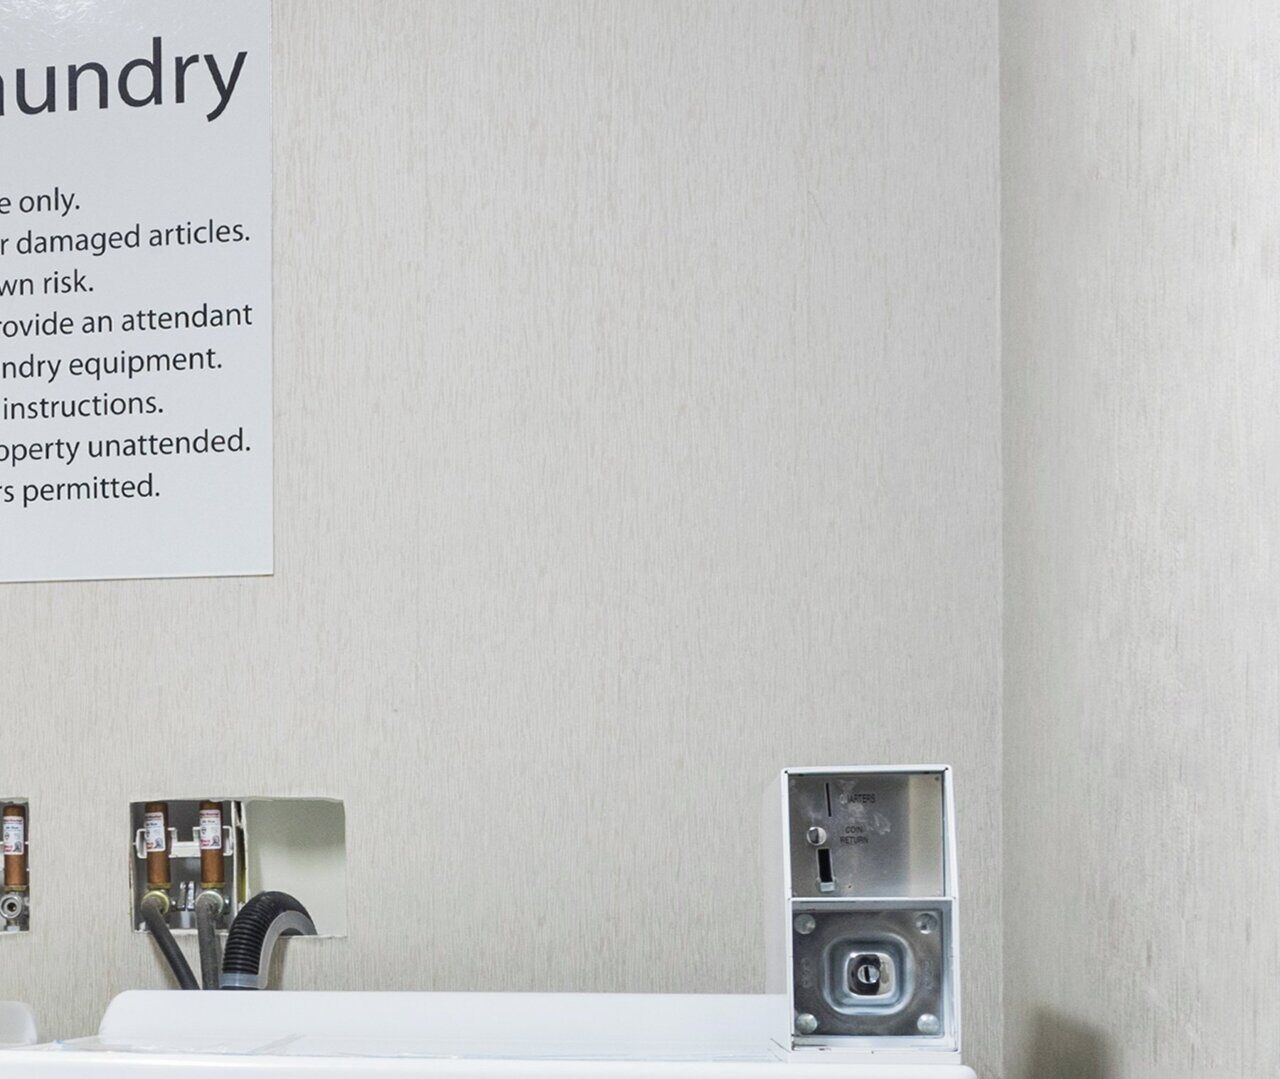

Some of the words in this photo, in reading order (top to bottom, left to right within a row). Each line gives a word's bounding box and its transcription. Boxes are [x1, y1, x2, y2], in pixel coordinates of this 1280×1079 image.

[19, 187, 80, 217] only.
[16, 223, 139, 256] damaged
[149, 219, 250, 246] articles.
[44, 269, 93, 294] risk.
[82, 315, 112, 333] an
[122, 303, 252, 331] attendant
[69, 349, 222, 381] equipment.
[4, 393, 163, 420] instructions.
[89, 427, 250, 458] unattended.
[23, 473, 160, 508] permitted.
[840, 792, 876, 803] QUARTERS
[840, 836, 869, 844] RETURN
